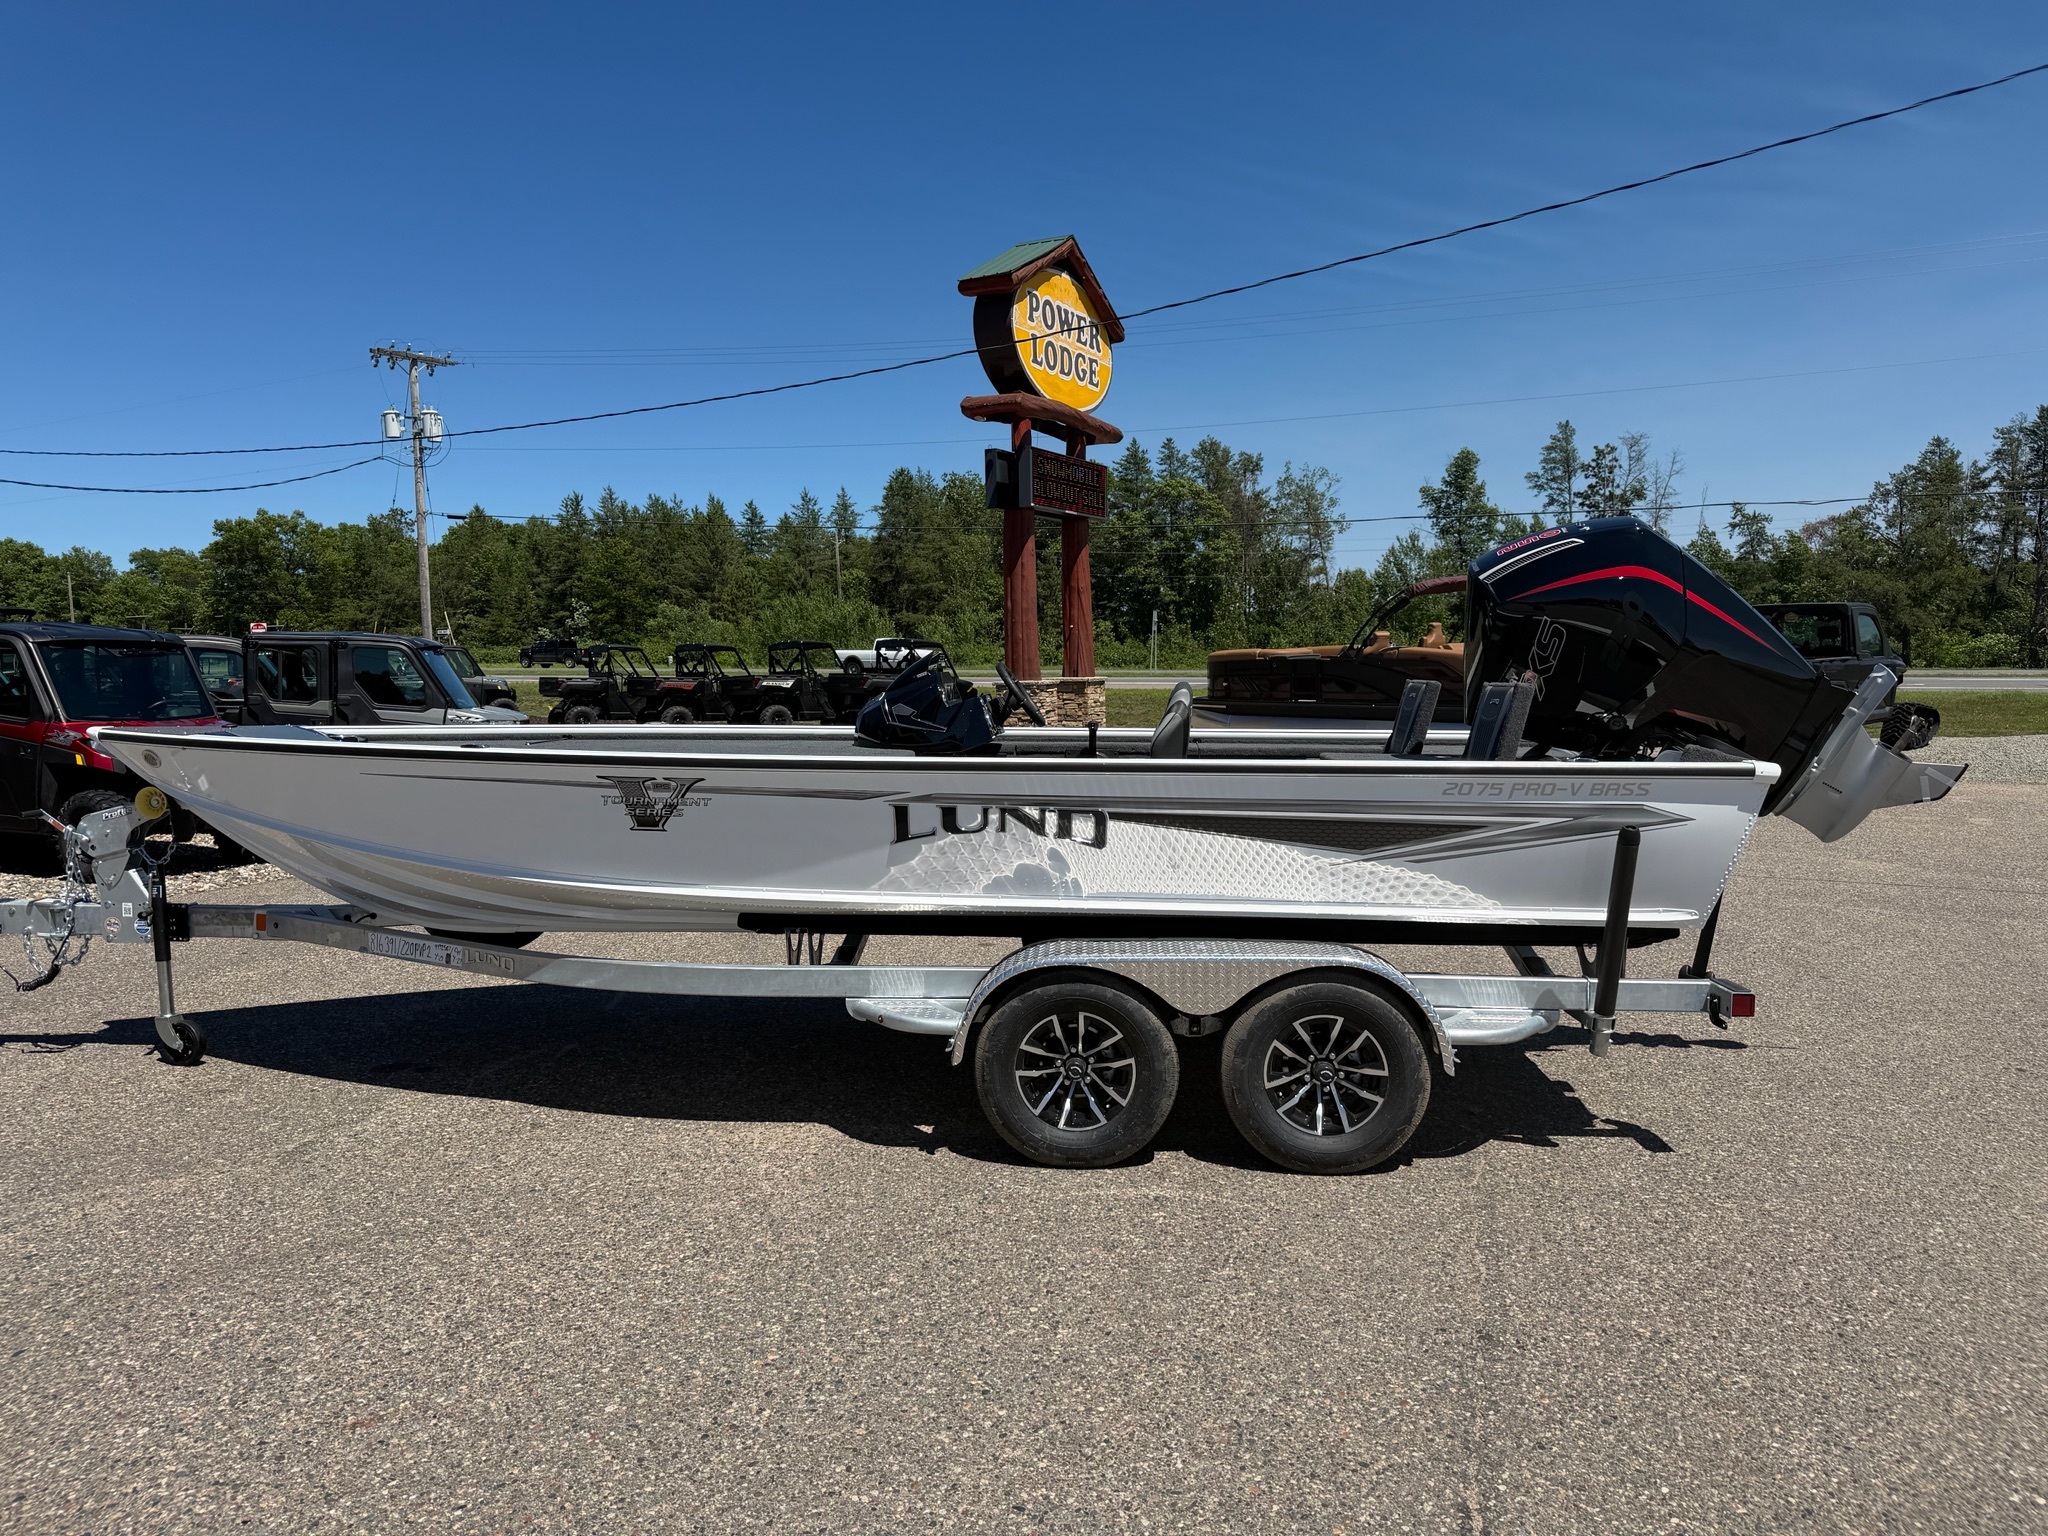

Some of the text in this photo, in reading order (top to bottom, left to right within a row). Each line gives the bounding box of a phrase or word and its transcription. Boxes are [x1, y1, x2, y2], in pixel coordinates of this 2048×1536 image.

[1027, 290, 1102, 354] POWER
[1030, 333, 1100, 390] LODGE
[1082, 489, 1105, 508] SALE
[601, 795, 713, 807] TOURNAMENT
[1441, 782, 1653, 800] 2075 PRO-V BASS
[624, 807, 685, 818] SERIES
[888, 803, 1109, 850] LUND
[464, 948, 516, 974] LUND
